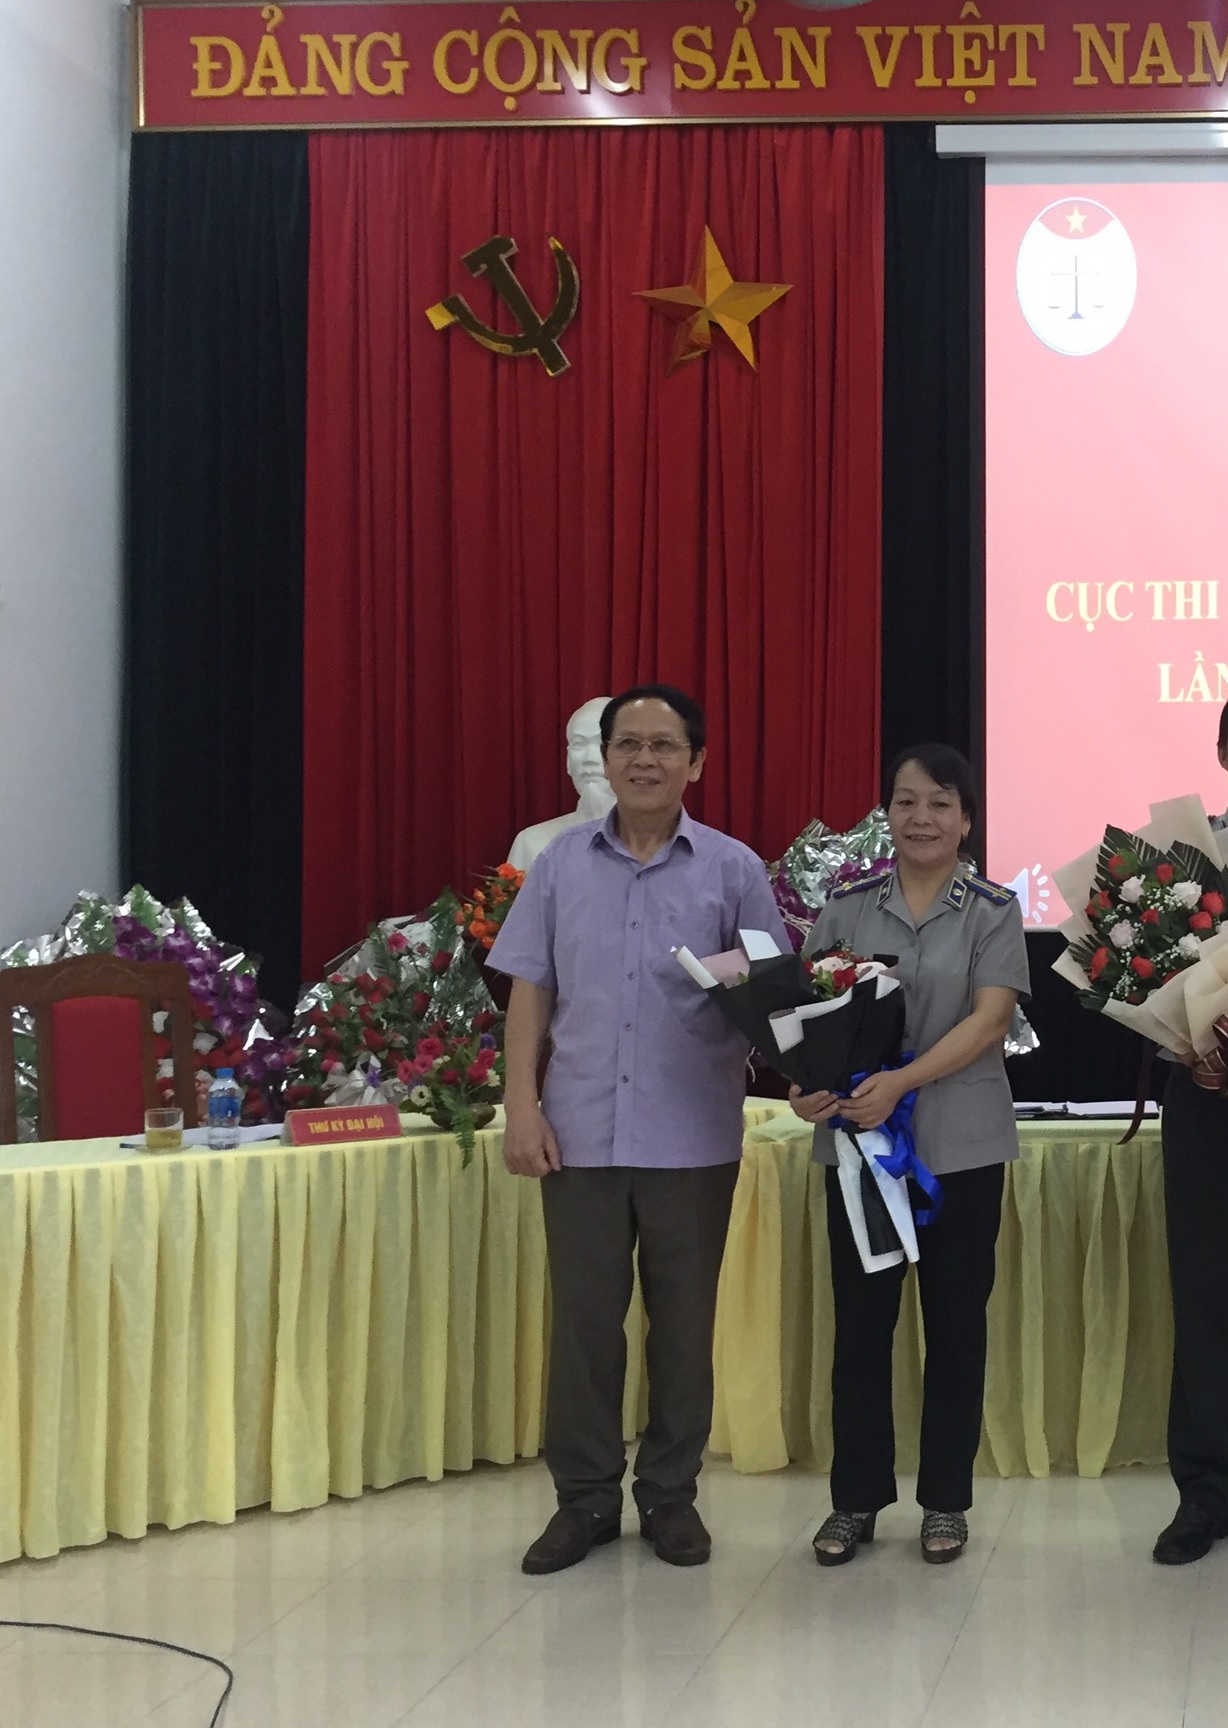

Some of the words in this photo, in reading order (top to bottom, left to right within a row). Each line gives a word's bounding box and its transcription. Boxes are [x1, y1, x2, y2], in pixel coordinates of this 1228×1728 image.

[191, 5, 409, 98] ĐẢNG
[433, 6, 647, 114] CỘNG
[673, 0, 831, 89] SẢN
[857, 0, 1045, 104] VIỆT
[1046, 580, 1134, 633] CỤC
[1144, 580, 1219, 621] THI
